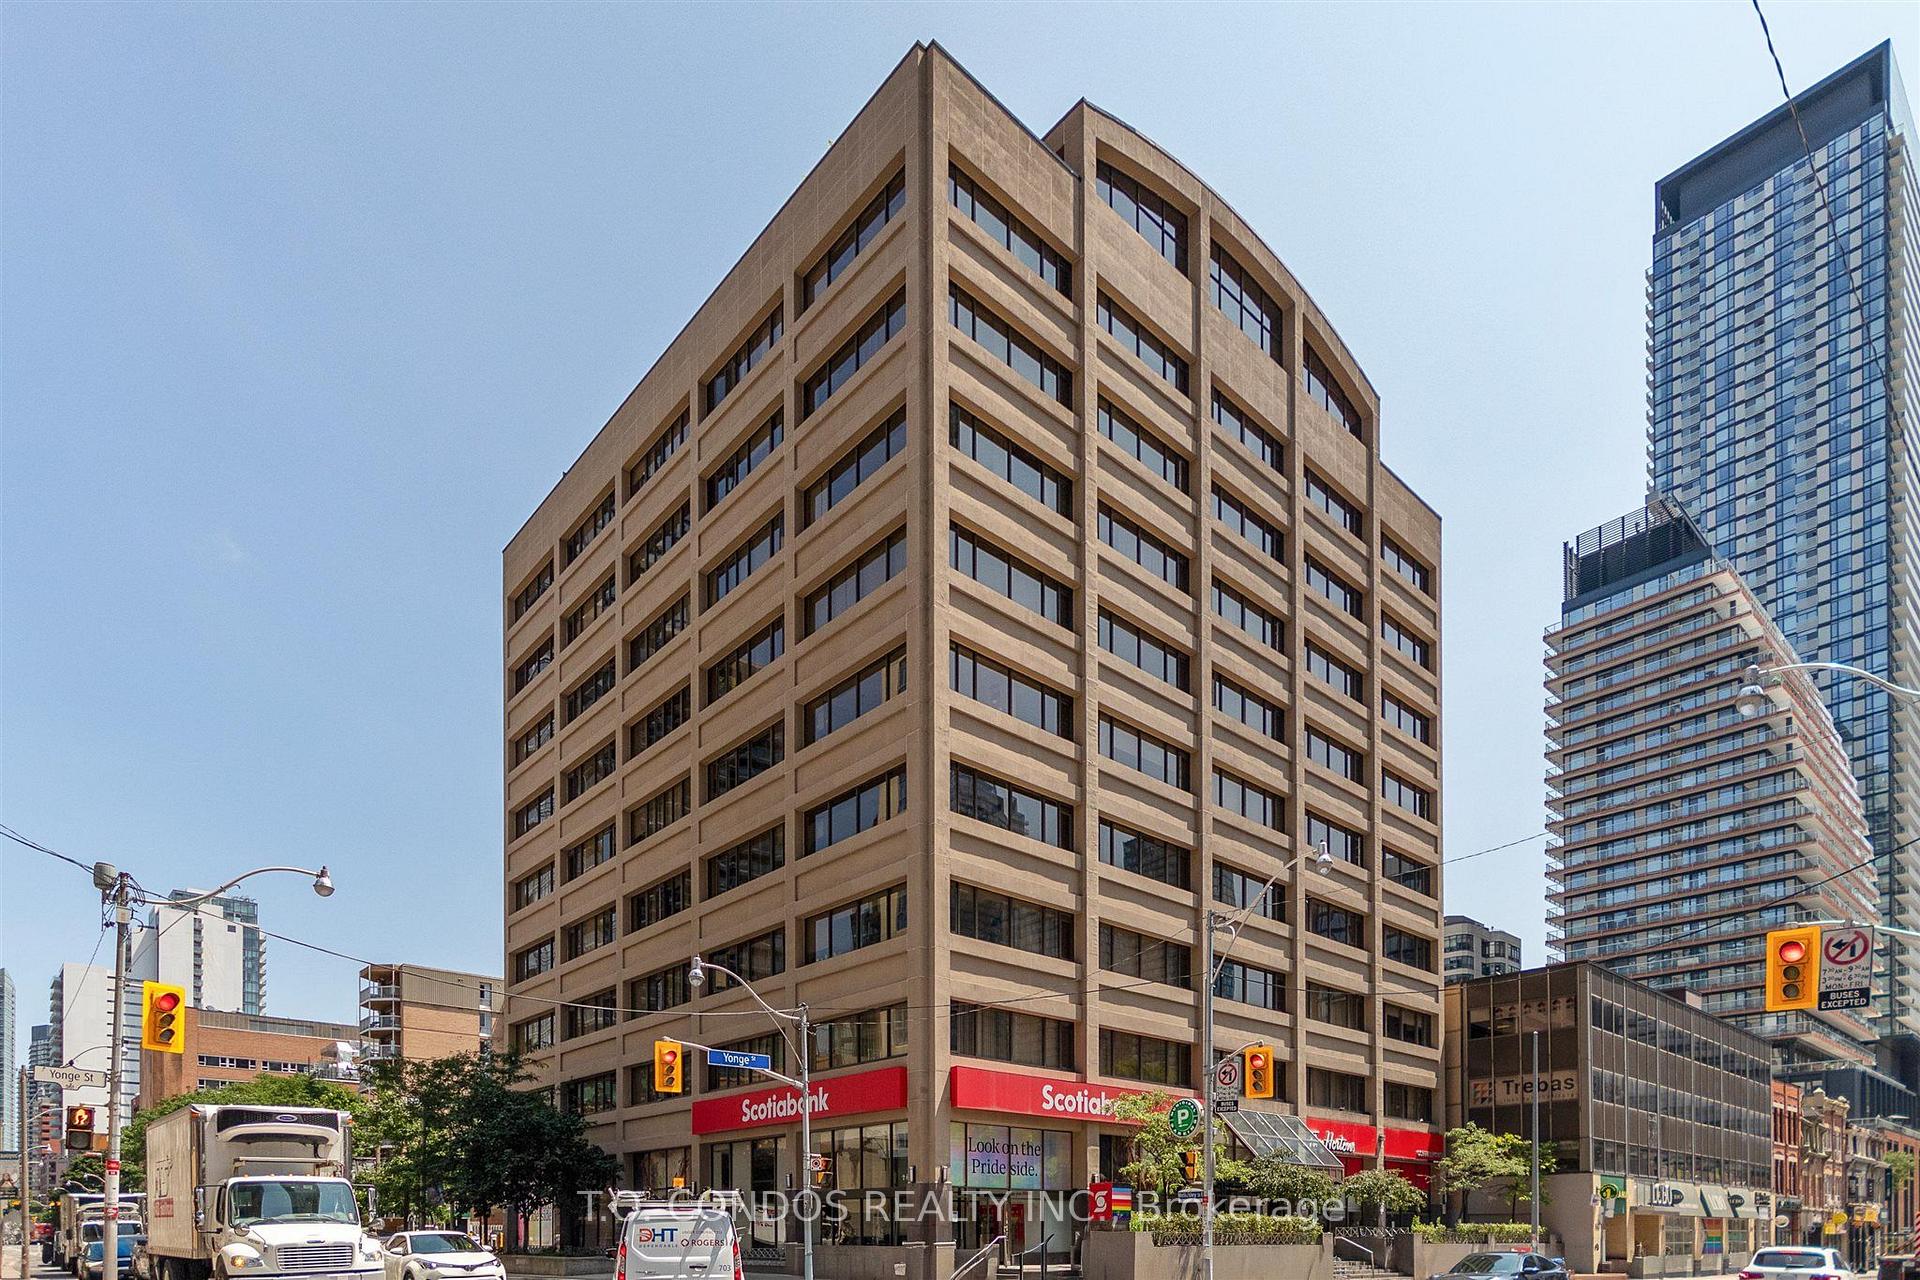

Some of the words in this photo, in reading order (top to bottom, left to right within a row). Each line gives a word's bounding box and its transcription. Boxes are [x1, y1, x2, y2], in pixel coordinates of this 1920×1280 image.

[1830, 990, 1860, 1000] BUSES
[1821, 998, 1867, 1009] EXCEPTED
[723, 1052, 750, 1066] Yonge
[49, 1069, 80, 1082] Yonge
[84, 1072, 94, 1082] St
[1502, 1077, 1575, 1095] Trebas
[1041, 1084, 1115, 1117] Scotiab
[1177, 1109, 1190, 1125] P
[967, 1136, 999, 1154] Look
[1001, 1143, 1019, 1155] on
[1020, 1141, 1041, 1157] the
[972, 1158, 1006, 1175] Pride
[1010, 1161, 1038, 1177] side.
[639, 1228, 678, 1242] DHT
[691, 1239, 725, 1247] ROGERS
[719, 1264, 731, 1272] 703
